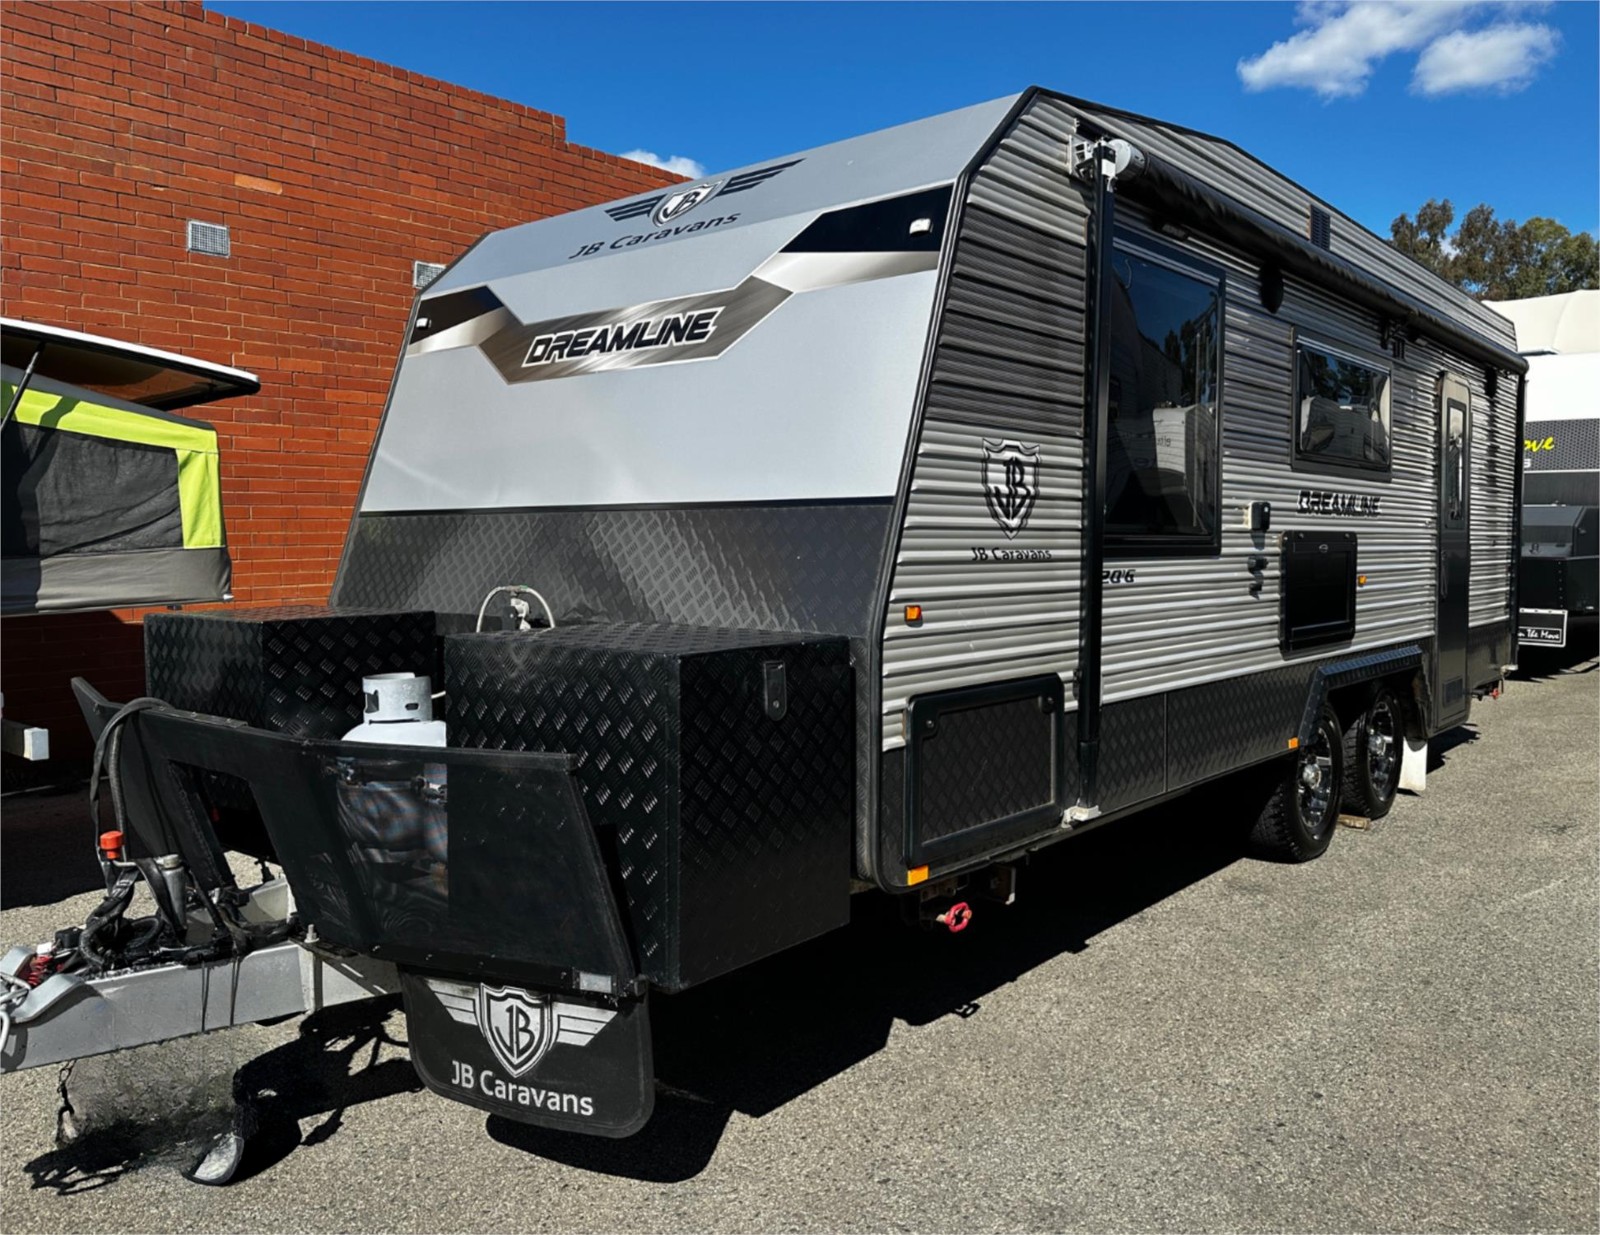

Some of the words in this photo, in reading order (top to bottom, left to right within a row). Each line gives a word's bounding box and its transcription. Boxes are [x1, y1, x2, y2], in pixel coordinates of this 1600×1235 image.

[568, 241, 605, 260] JB
[609, 211, 741, 251] Caravans
[522, 306, 725, 368] DREAMLINE
[1523, 436, 1555, 452] ove
[1297, 490, 1382, 516] DREAMLINE
[971, 547, 989, 561] JB
[992, 547, 1052, 561] Caravans
[1540, 630, 1560, 639] Move
[451, 1060, 475, 1089] JB
[479, 1070, 594, 1116] Caravans
